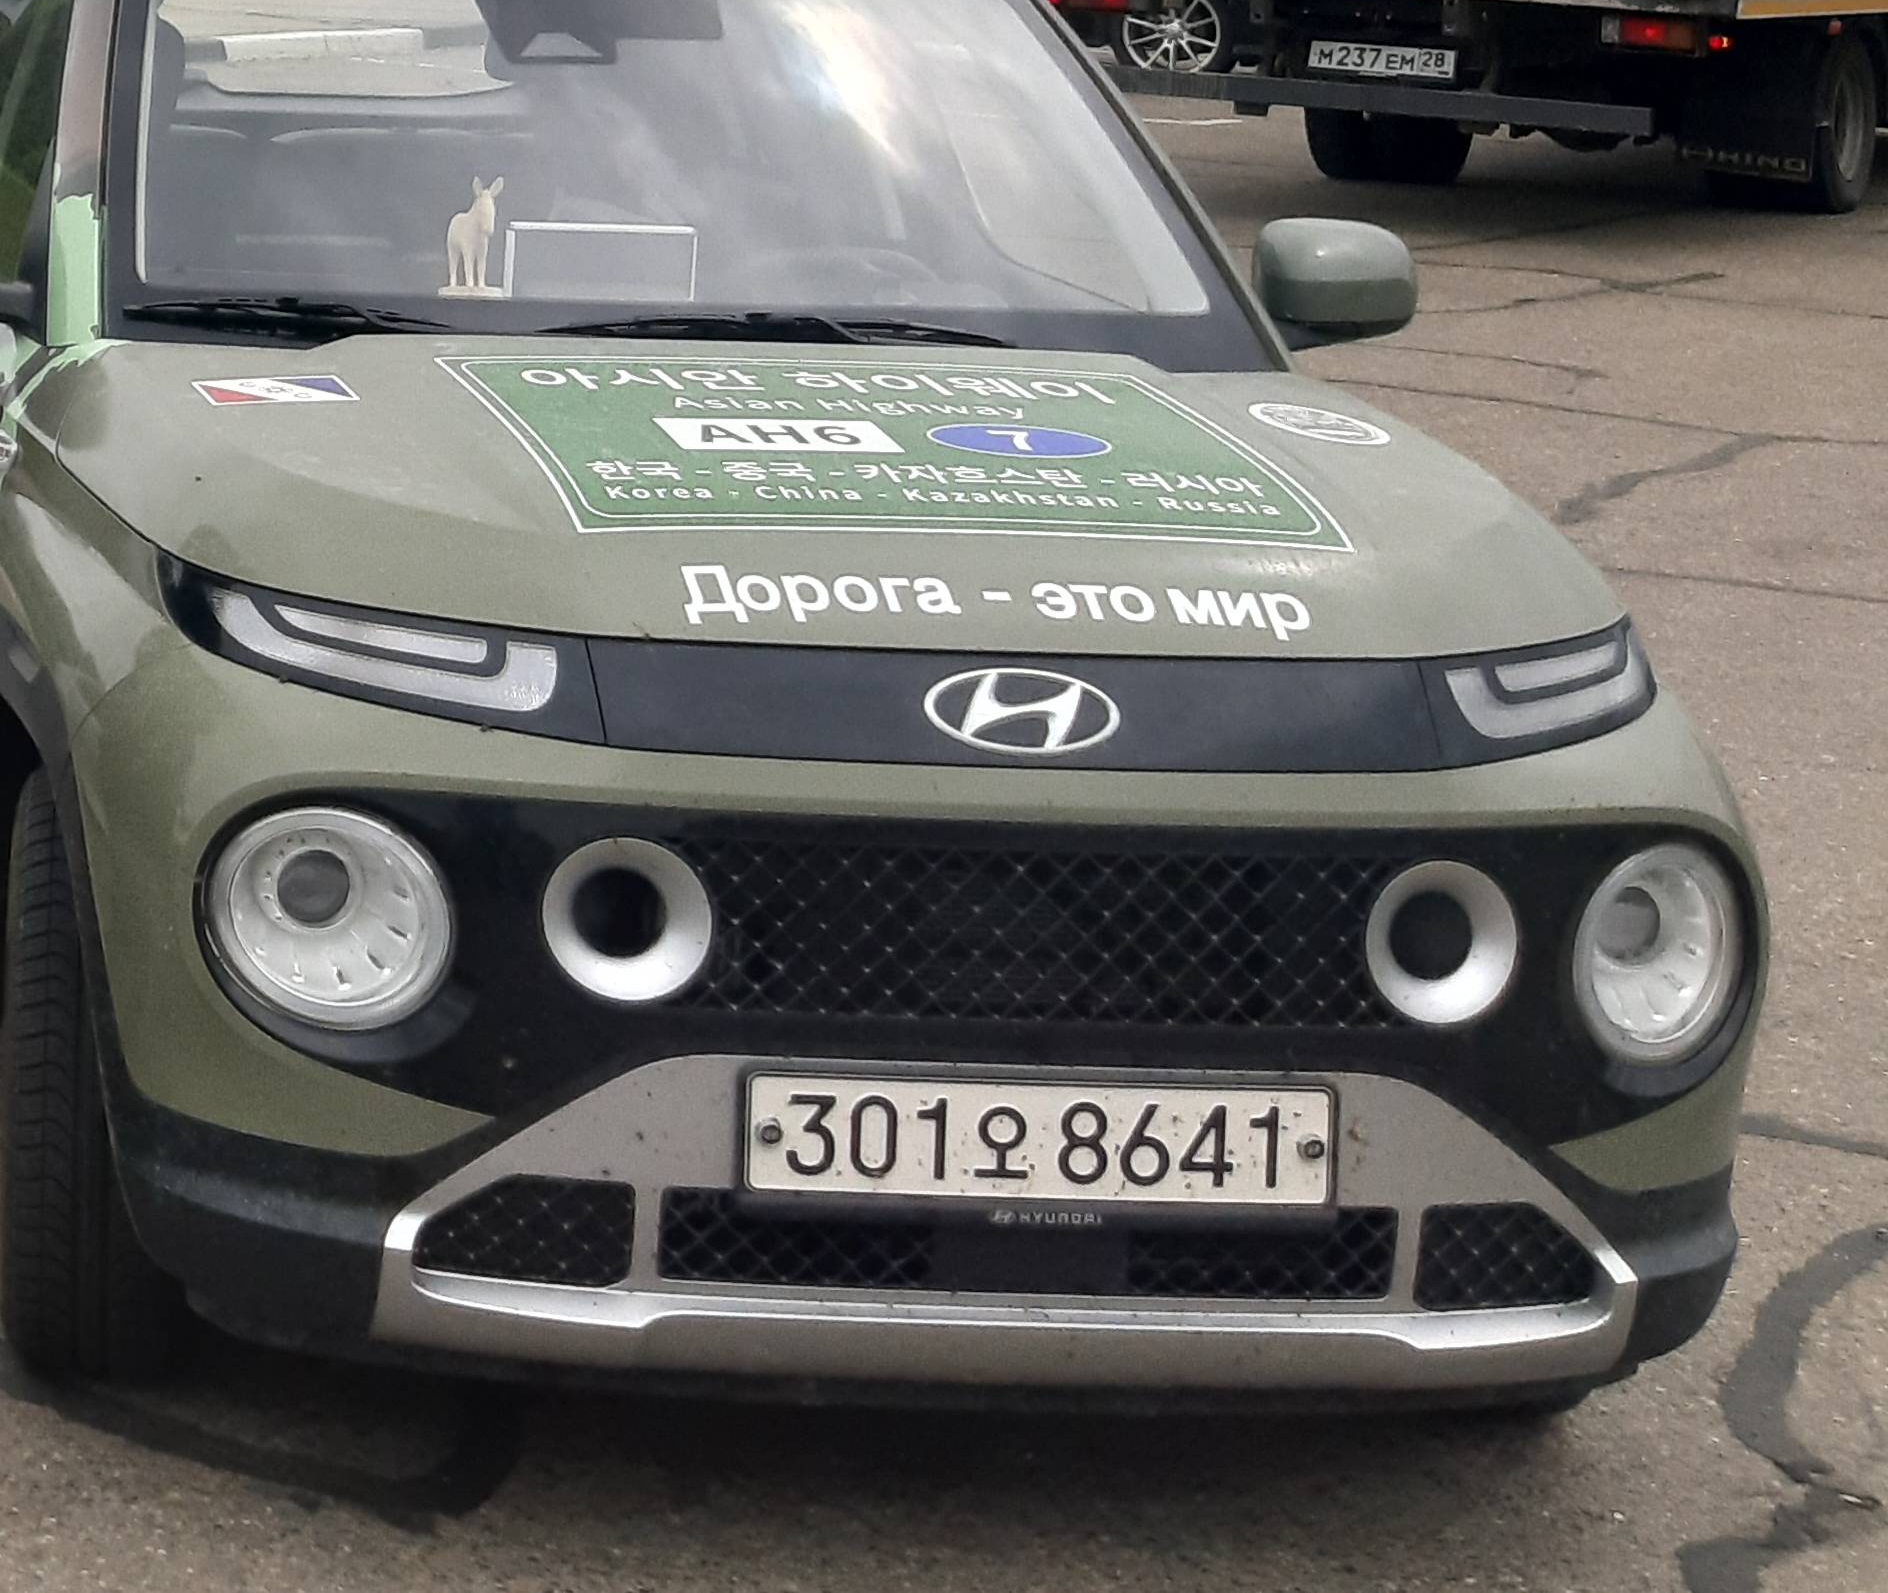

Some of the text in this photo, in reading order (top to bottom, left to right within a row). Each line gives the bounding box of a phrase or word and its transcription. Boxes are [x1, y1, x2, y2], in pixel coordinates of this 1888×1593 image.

[520, 367, 1116, 405] 아시안 하이웨이
[673, 395, 1025, 420] Asian Highway
[699, 424, 863, 446] AH6
[985, 430, 1034, 452] 7
[585, 459, 684, 481] 한국
[721, 460, 817, 482] 중국
[853, 462, 1088, 490] 카자흐스탄
[1121, 471, 1266, 498] 러시아
[603, 485, 715, 500] Korea
[754, 485, 864, 501] China
[902, 488, 1121, 508] Kazakhstan
[1156, 496, 1282, 517] Russia
[680, 564, 963, 625] Дорога
[1030, 581, 1158, 622] это
[1164, 587, 1313, 642] мир
[1019, 1211, 1103, 1224] HYUNDAI
